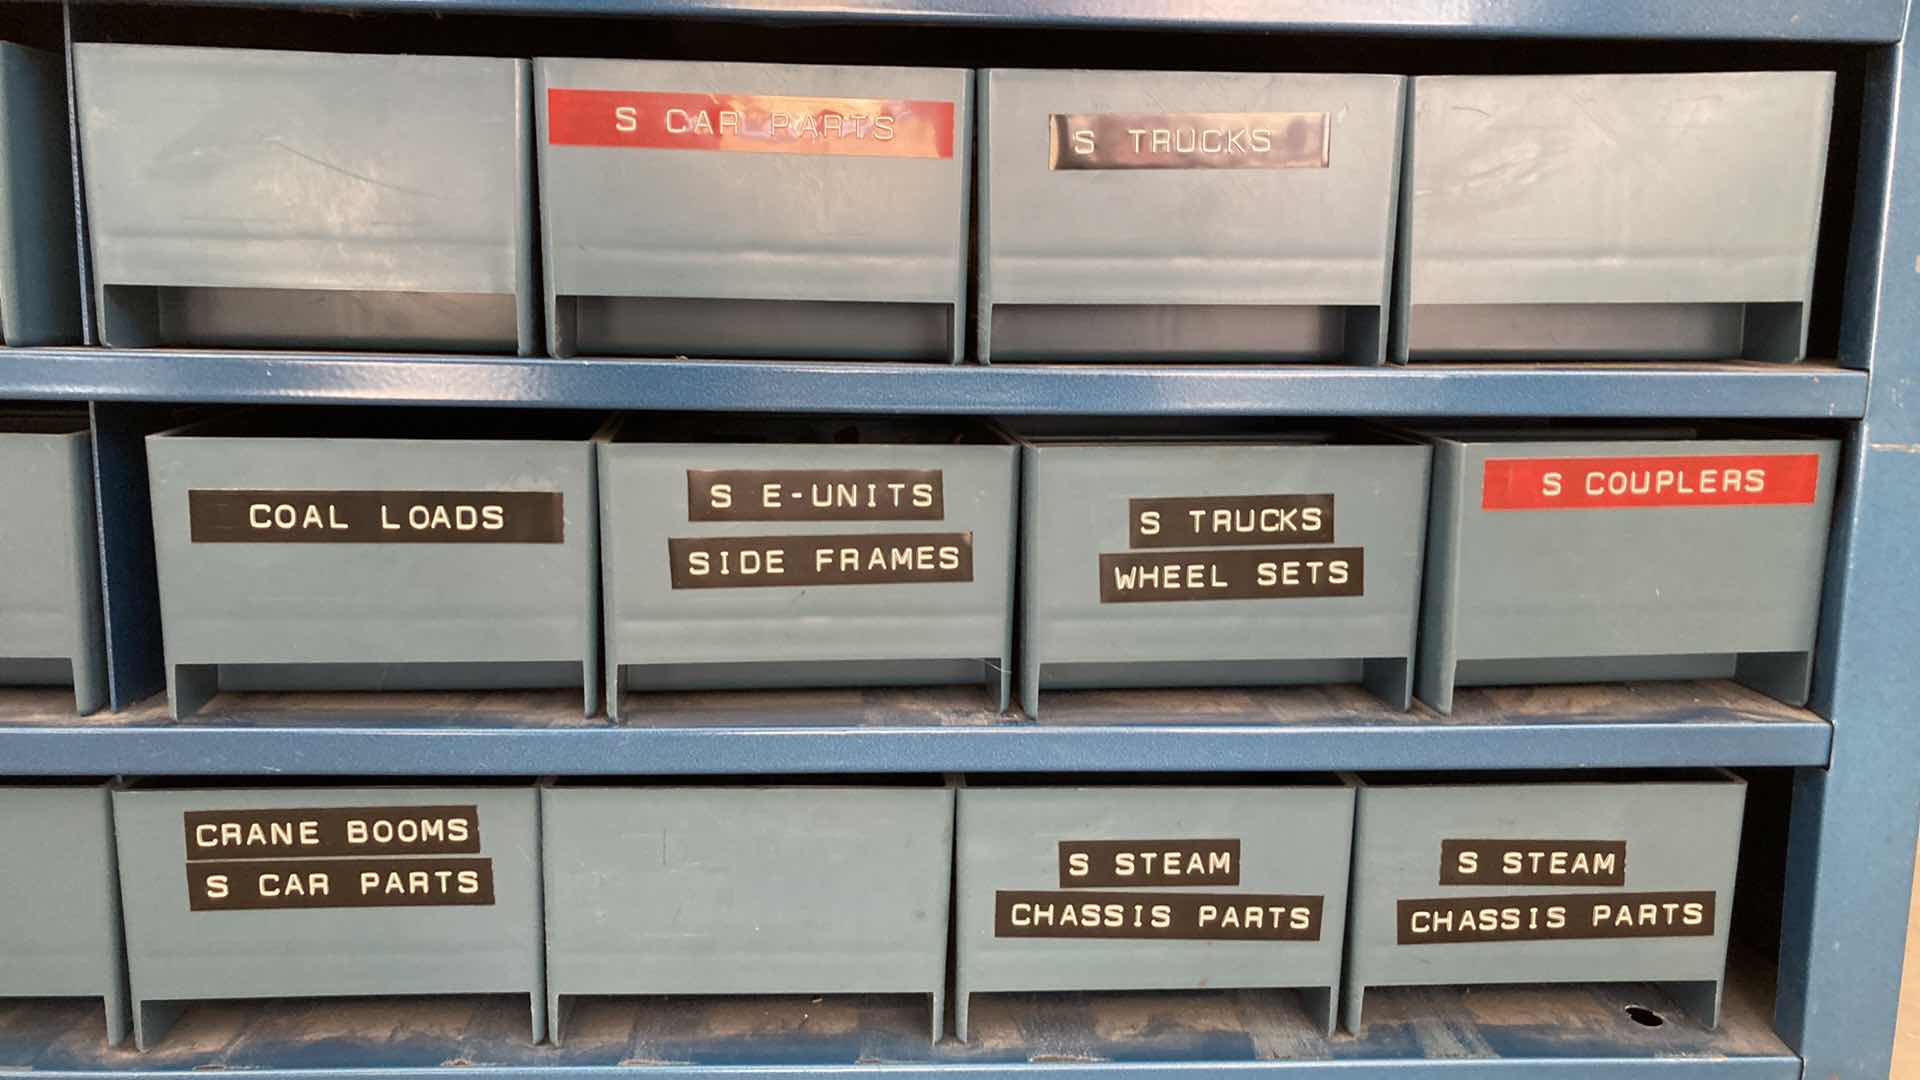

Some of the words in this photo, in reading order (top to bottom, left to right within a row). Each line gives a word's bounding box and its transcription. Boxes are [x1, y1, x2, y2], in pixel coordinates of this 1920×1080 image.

[615, 106, 638, 132] S
[665, 108, 740, 137] CAR
[769, 110, 896, 141] PARTS
[1072, 129, 1096, 154] S
[1127, 128, 1272, 154] TRUCKS
[710, 484, 732, 508] S
[763, 483, 933, 508] E-UNITS
[1542, 471, 1563, 497] S
[1585, 468, 1766, 496] COUPLERS
[249, 503, 349, 529] COAL
[381, 505, 504, 531] LOADS
[1140, 511, 1161, 535] S
[1188, 507, 1322, 534] TRUCKS
[688, 549, 785, 576] SIDE
[815, 546, 959, 573] FRAMES
[1114, 564, 1229, 591] WHEEL
[1257, 560, 1349, 586] SETS
[196, 821, 320, 847] CRANE
[346, 818, 469, 844] BOOMS
[1068, 853, 1089, 877] S
[1115, 851, 1231, 876] STEAM
[1458, 851, 1479, 874] S
[1502, 851, 1616, 875] STEAM
[206, 875, 229, 899] S
[258, 873, 329, 897] CAR
[360, 870, 479, 895] PARTS
[1011, 903, 1171, 928] CHASSIS
[1198, 905, 1311, 930] PARTS
[1411, 906, 1566, 933] CHASSIS
[1592, 902, 1704, 927] PARTS
